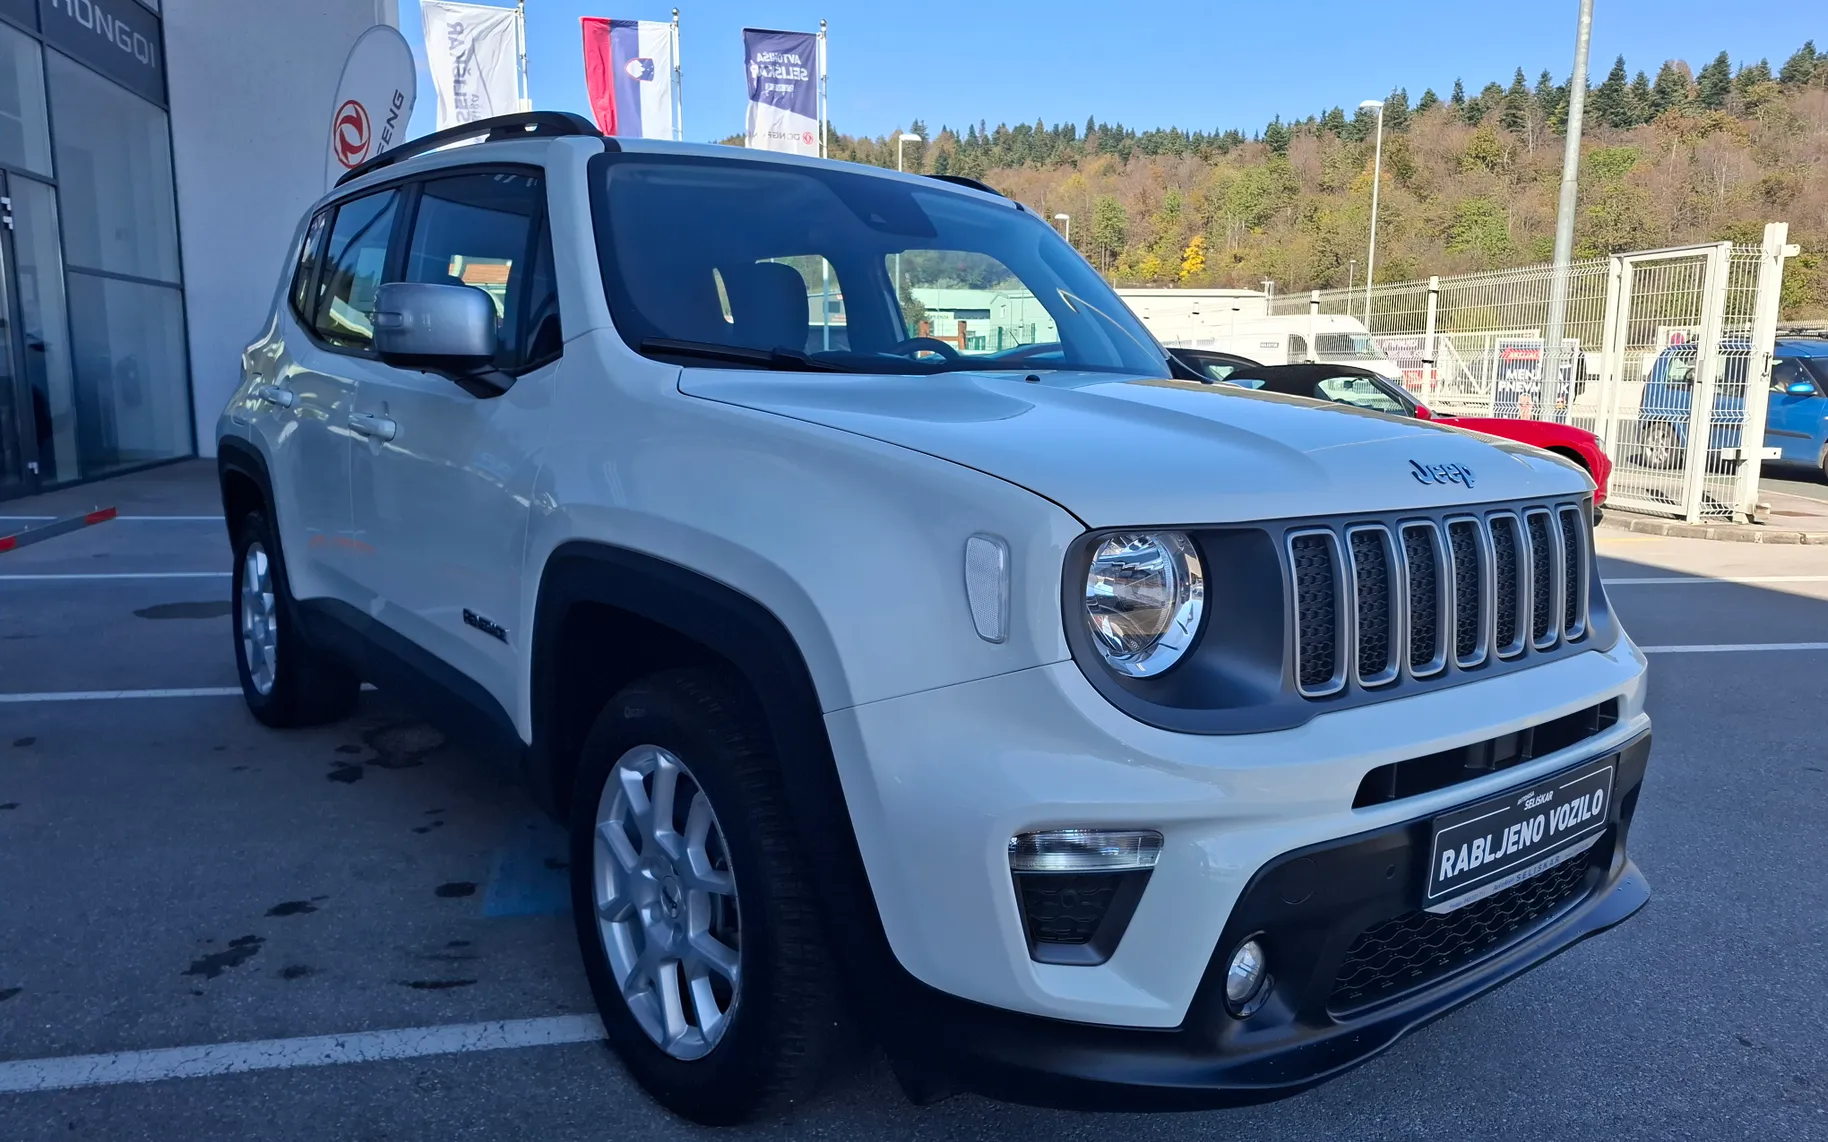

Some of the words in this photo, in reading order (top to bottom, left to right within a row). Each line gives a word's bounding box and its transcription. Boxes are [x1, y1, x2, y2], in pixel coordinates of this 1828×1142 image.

[376, 88, 405, 155] FENG
[1409, 459, 1475, 489] Jeep
[1439, 814, 1545, 881] RABLJENO
[1550, 788, 1603, 836] VOZILO
